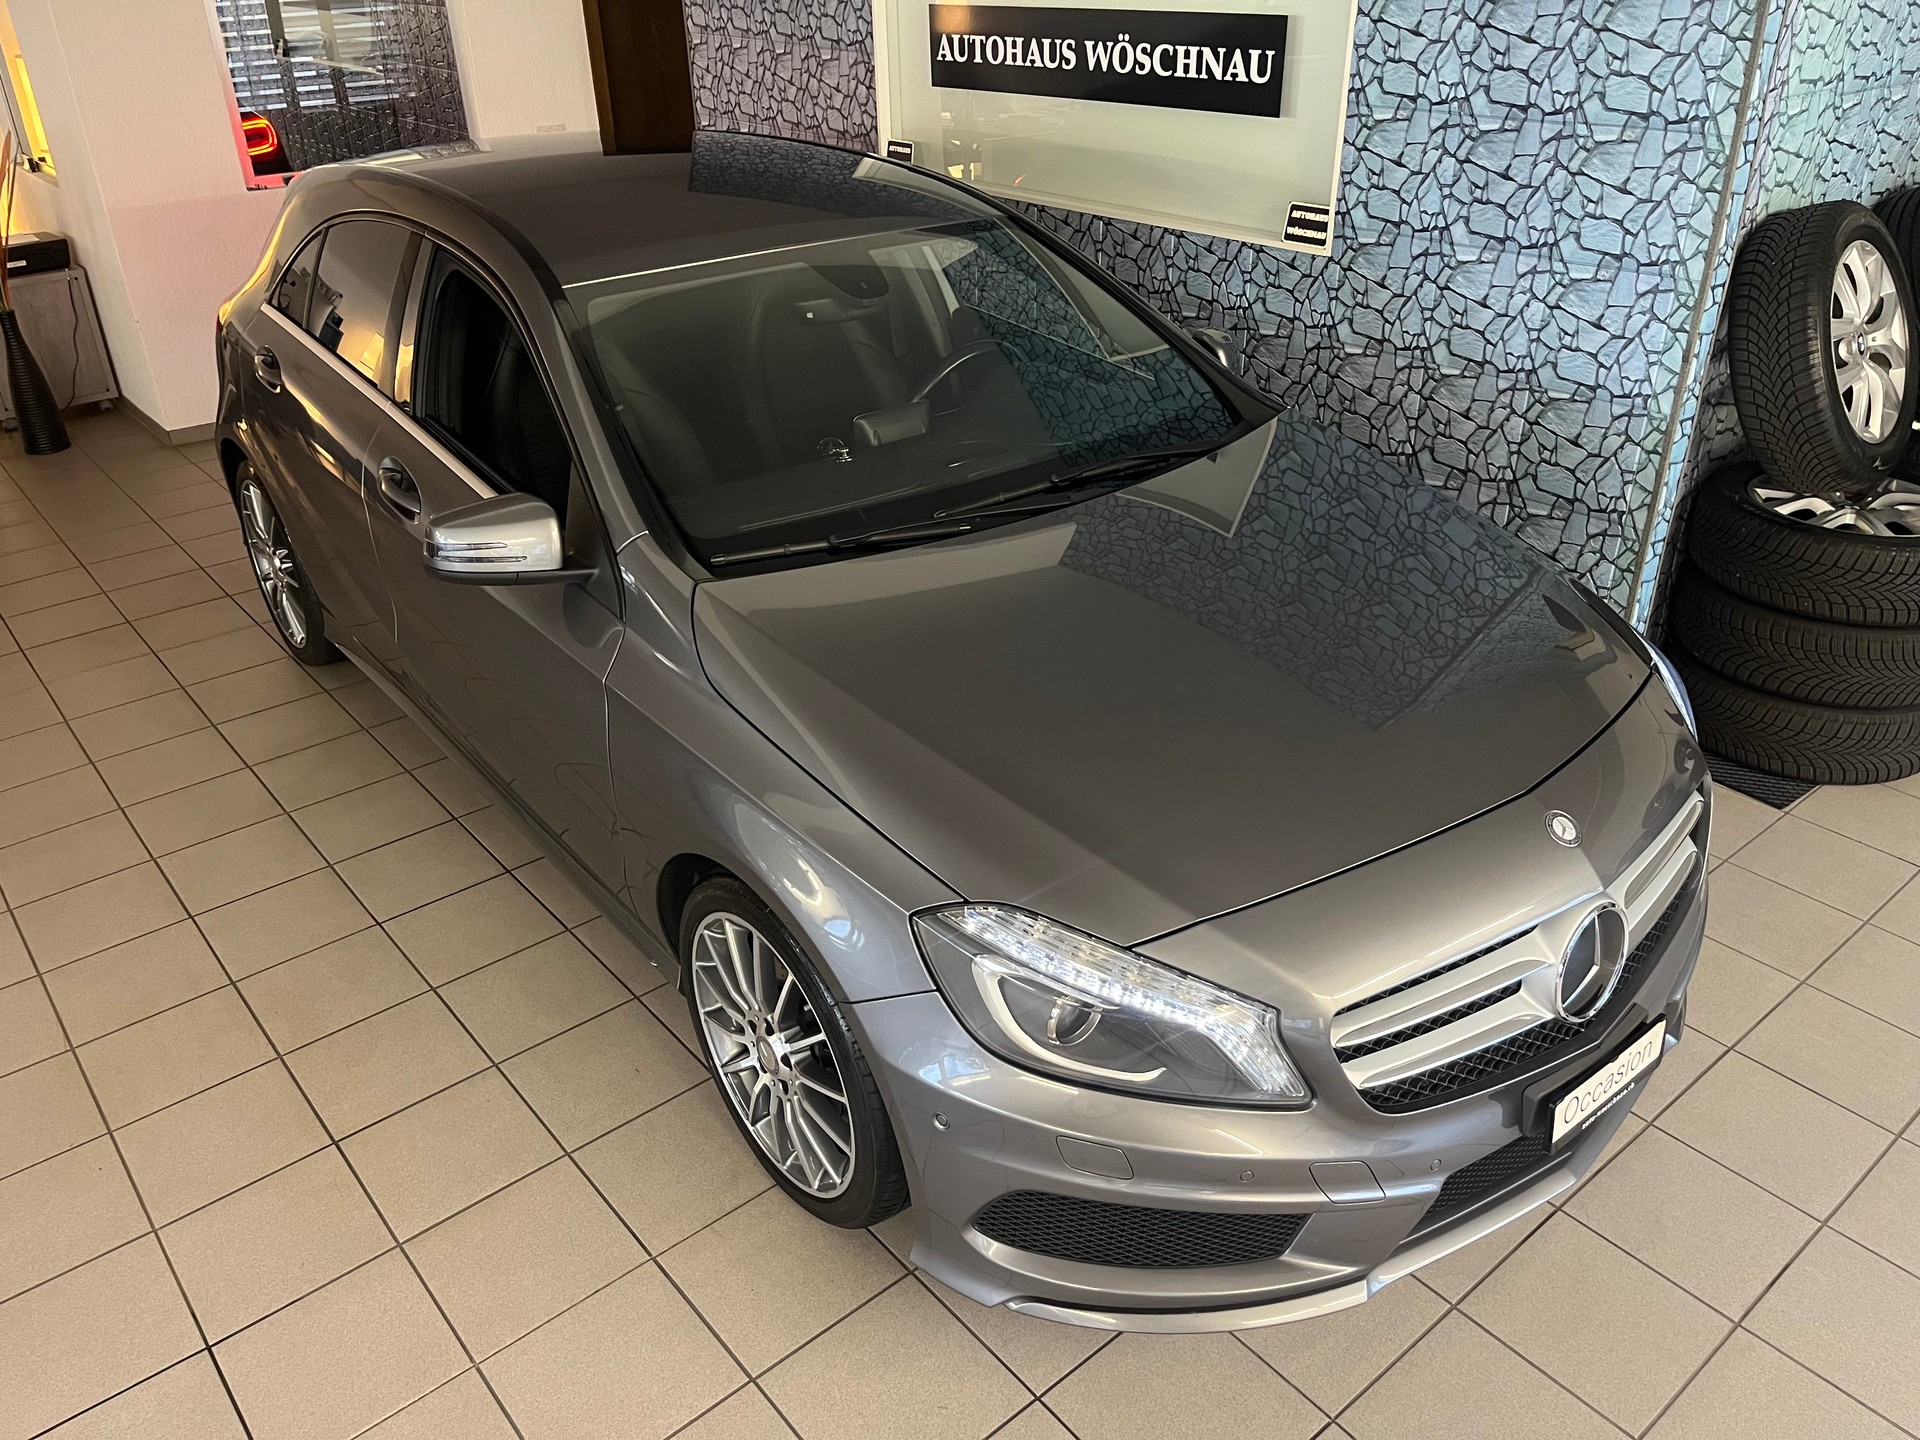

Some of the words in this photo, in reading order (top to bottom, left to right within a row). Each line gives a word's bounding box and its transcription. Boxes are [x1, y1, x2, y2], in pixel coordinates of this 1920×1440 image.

[936, 33, 1077, 70] AUTOHAUS
[1085, 33, 1276, 85] WÖSCHNAU
[1286, 226, 1327, 240] WÖSCHNAU
[1291, 210, 1329, 223] AUTOHAUS
[1563, 1041, 1653, 1124] Occasion
